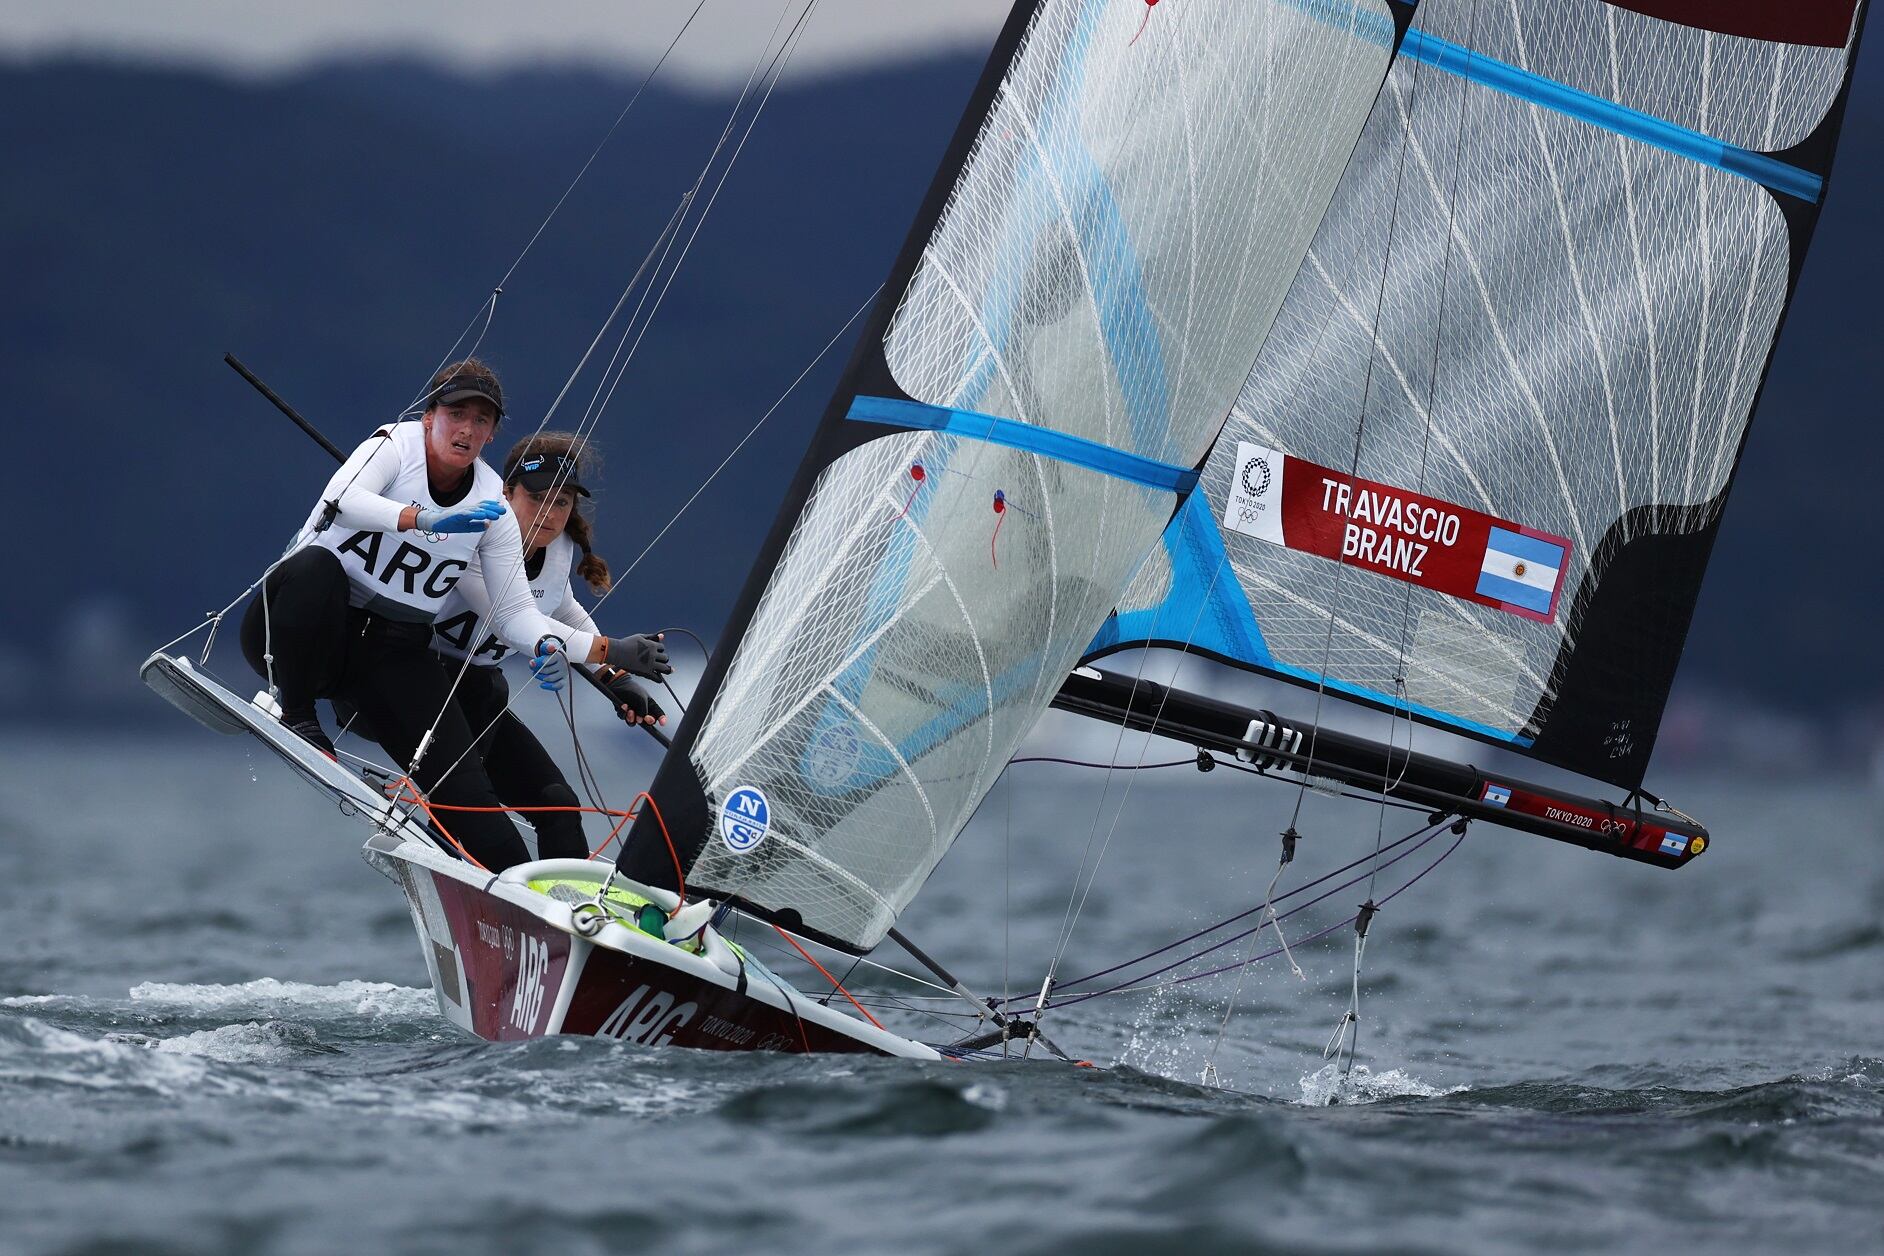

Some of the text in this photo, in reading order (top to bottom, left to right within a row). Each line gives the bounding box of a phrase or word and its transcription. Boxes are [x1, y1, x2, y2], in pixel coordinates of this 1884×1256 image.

[1235, 495, 1266, 511] TOKYO 2020
[1322, 477, 1461, 547] TRAVASCIO
[337, 531, 468, 599] ARG
[1342, 523, 1429, 577] BRANZ
[1545, 806, 1593, 828] TOKYO 2020
[510, 931, 549, 1036] ARG
[592, 984, 699, 1047] ARG
